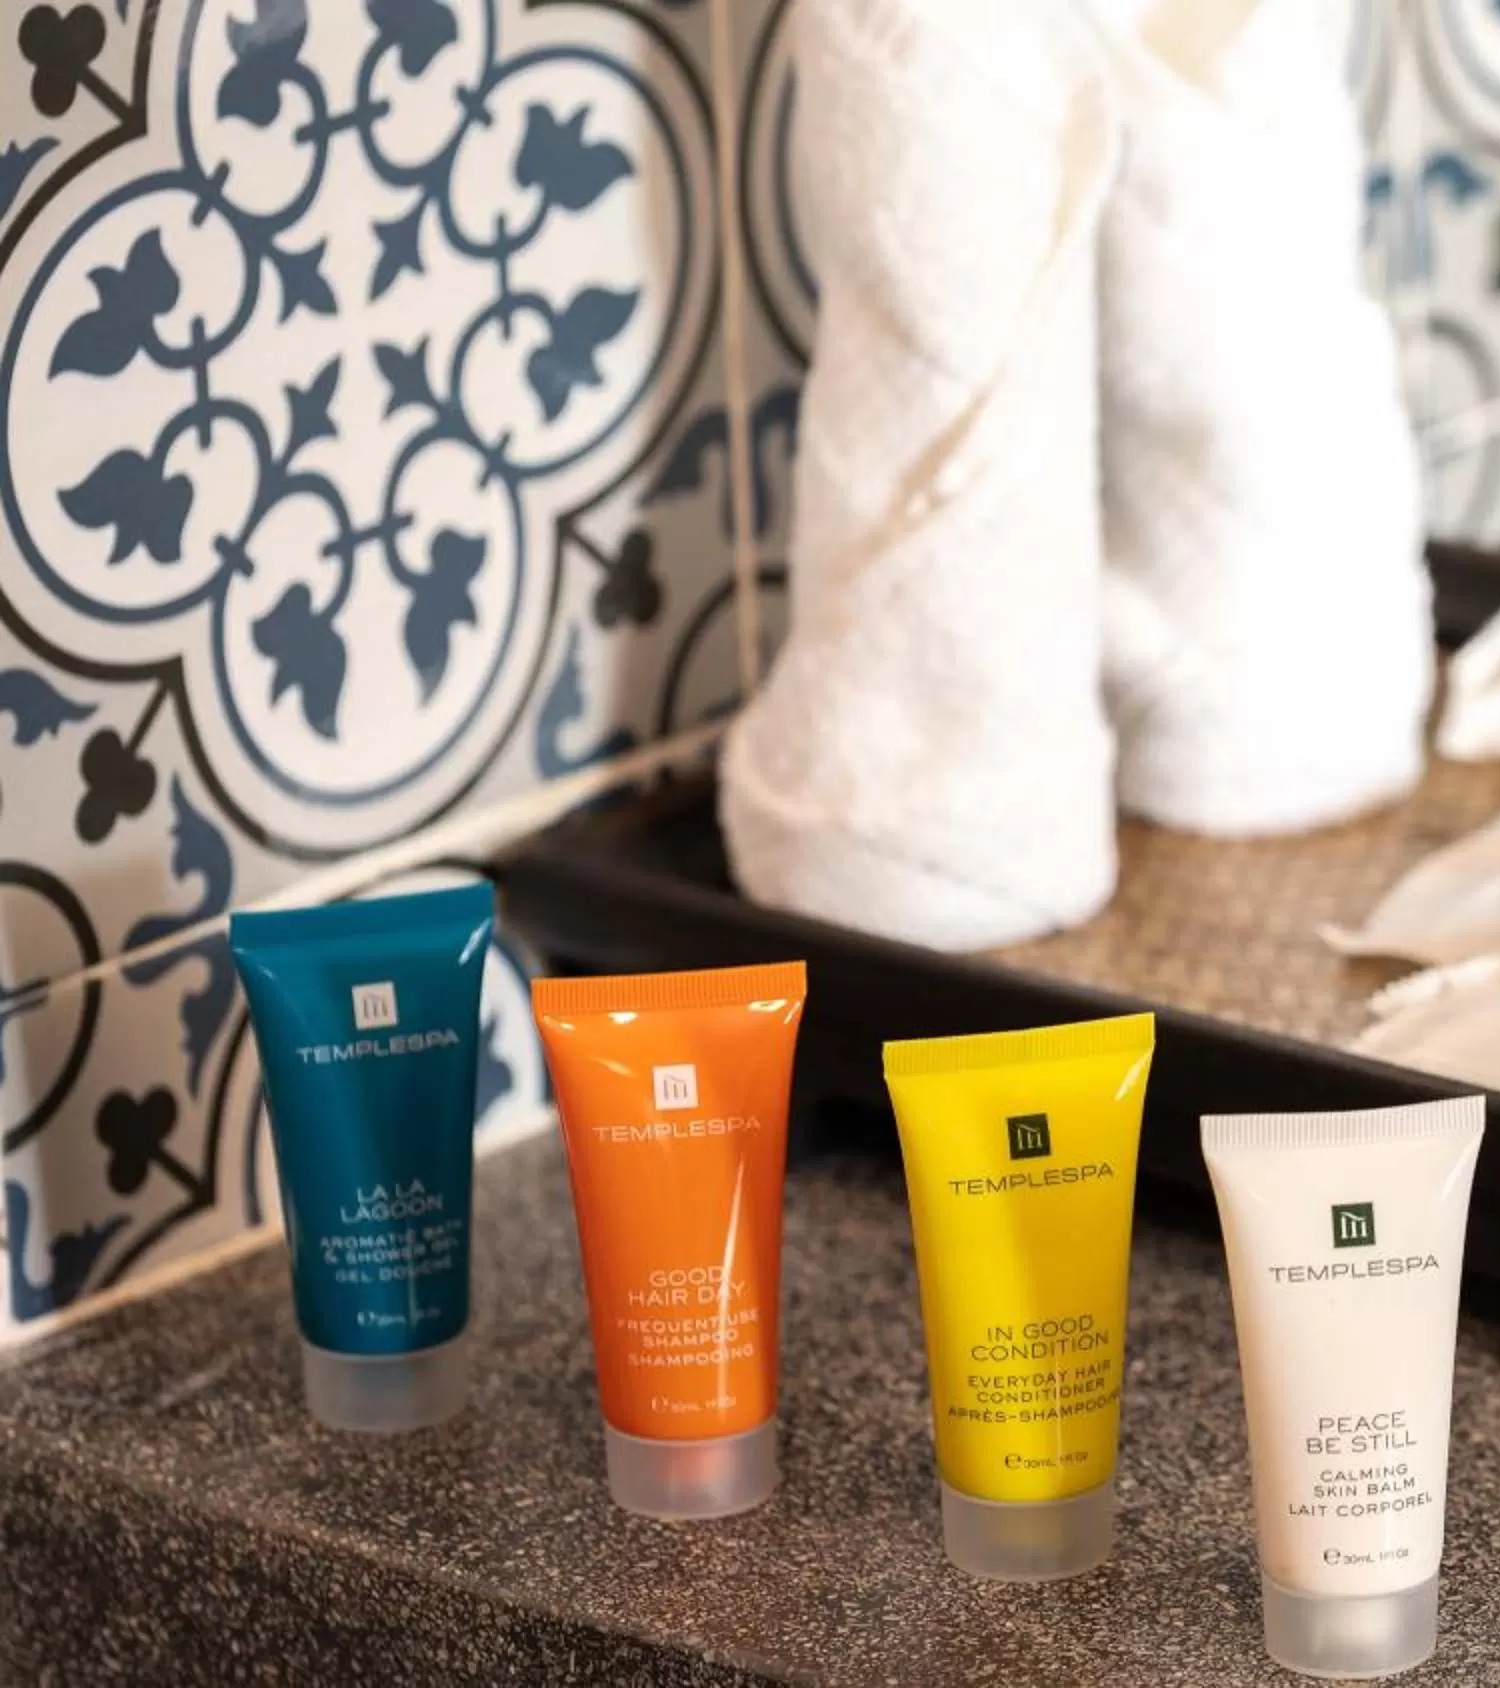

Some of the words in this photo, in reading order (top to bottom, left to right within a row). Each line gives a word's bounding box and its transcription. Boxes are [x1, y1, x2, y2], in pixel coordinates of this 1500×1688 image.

[297, 1028, 460, 1065] TEMPLESPA
[592, 1115, 761, 1143] TEMPLESPA
[357, 1184, 386, 1202] LA
[396, 1179, 425, 1197] LA
[949, 1162, 1114, 1196] TEMPLESPA
[340, 1194, 444, 1224] LAGOON
[650, 1265, 726, 1288] GOOD
[1269, 1254, 1440, 1283] TEMPLESPA
[628, 1288, 688, 1307] HAIR
[698, 1281, 745, 1305] DAY
[617, 1316, 720, 1333] FREQUENT
[987, 1326, 1013, 1343] IN
[1023, 1315, 1095, 1340] GOOD
[643, 1329, 738, 1349] SHAMPOO
[971, 1331, 1109, 1363] CONDITION
[628, 1343, 753, 1367] SHAMPOOING
[967, 1370, 1068, 1389] EVERYDAY
[1076, 1359, 1111, 1379] HAIR
[976, 1378, 1105, 1404] CONDITIONER
[1319, 1410, 1406, 1434] PEACE
[1306, 1436, 1341, 1455] BE
[1351, 1430, 1417, 1453] STILL
[1319, 1463, 1408, 1483] CALMING
[1313, 1484, 1357, 1498] SKIN
[1367, 1476, 1416, 1495] BALM
[1289, 1503, 1328, 1517] LAIT
[1336, 1492, 1432, 1518] CORPOREL
